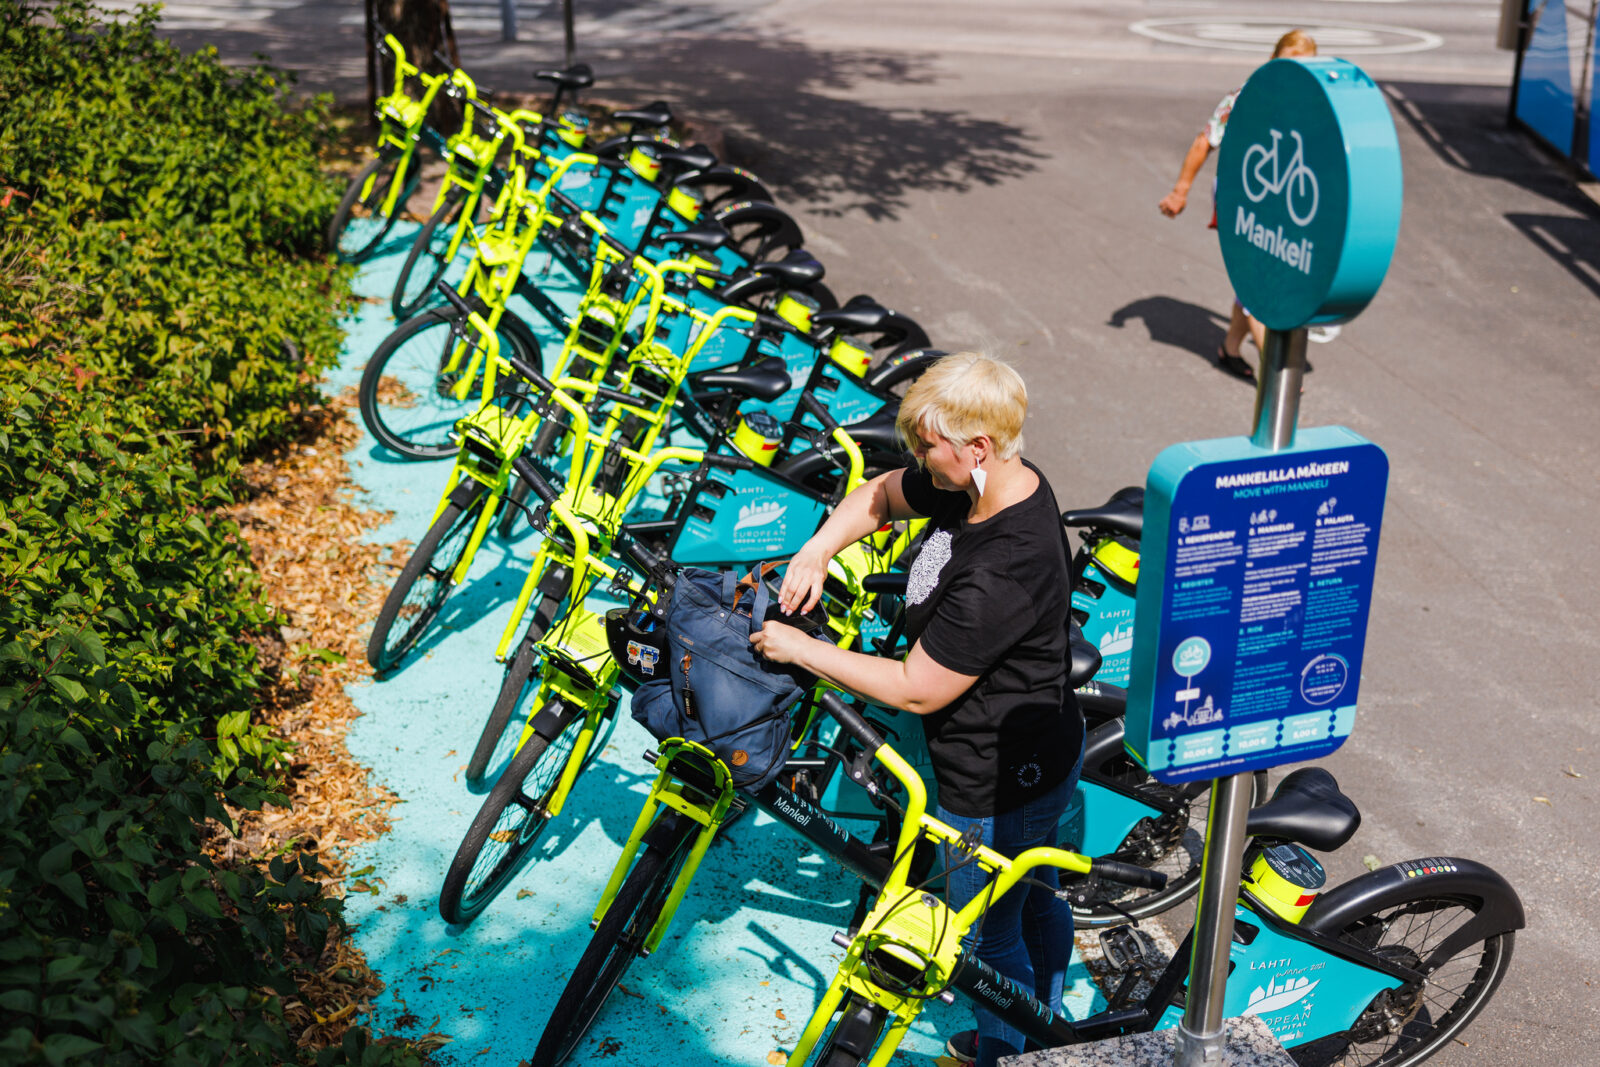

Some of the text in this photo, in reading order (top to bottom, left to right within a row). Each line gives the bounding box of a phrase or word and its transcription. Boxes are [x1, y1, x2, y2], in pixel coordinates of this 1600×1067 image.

[1235, 205, 1314, 275] Mankeli
[1216, 460, 1349, 489] MANKELILLA MÄKEEN
[736, 486, 764, 494] LAHTI
[1233, 478, 1329, 499] MOVE WITH MANKELI
[733, 529, 786, 538] EUROPEAN
[1100, 609, 1130, 619] LAHTI
[773, 796, 812, 827] Mankeli
[1250, 958, 1291, 970] LAHTI
[1310, 961, 1326, 971] 2021
[973, 979, 1014, 1010] Mankeli
[1265, 1011, 1311, 1026] OPEAN
[1270, 1021, 1307, 1033] CAPITAL
